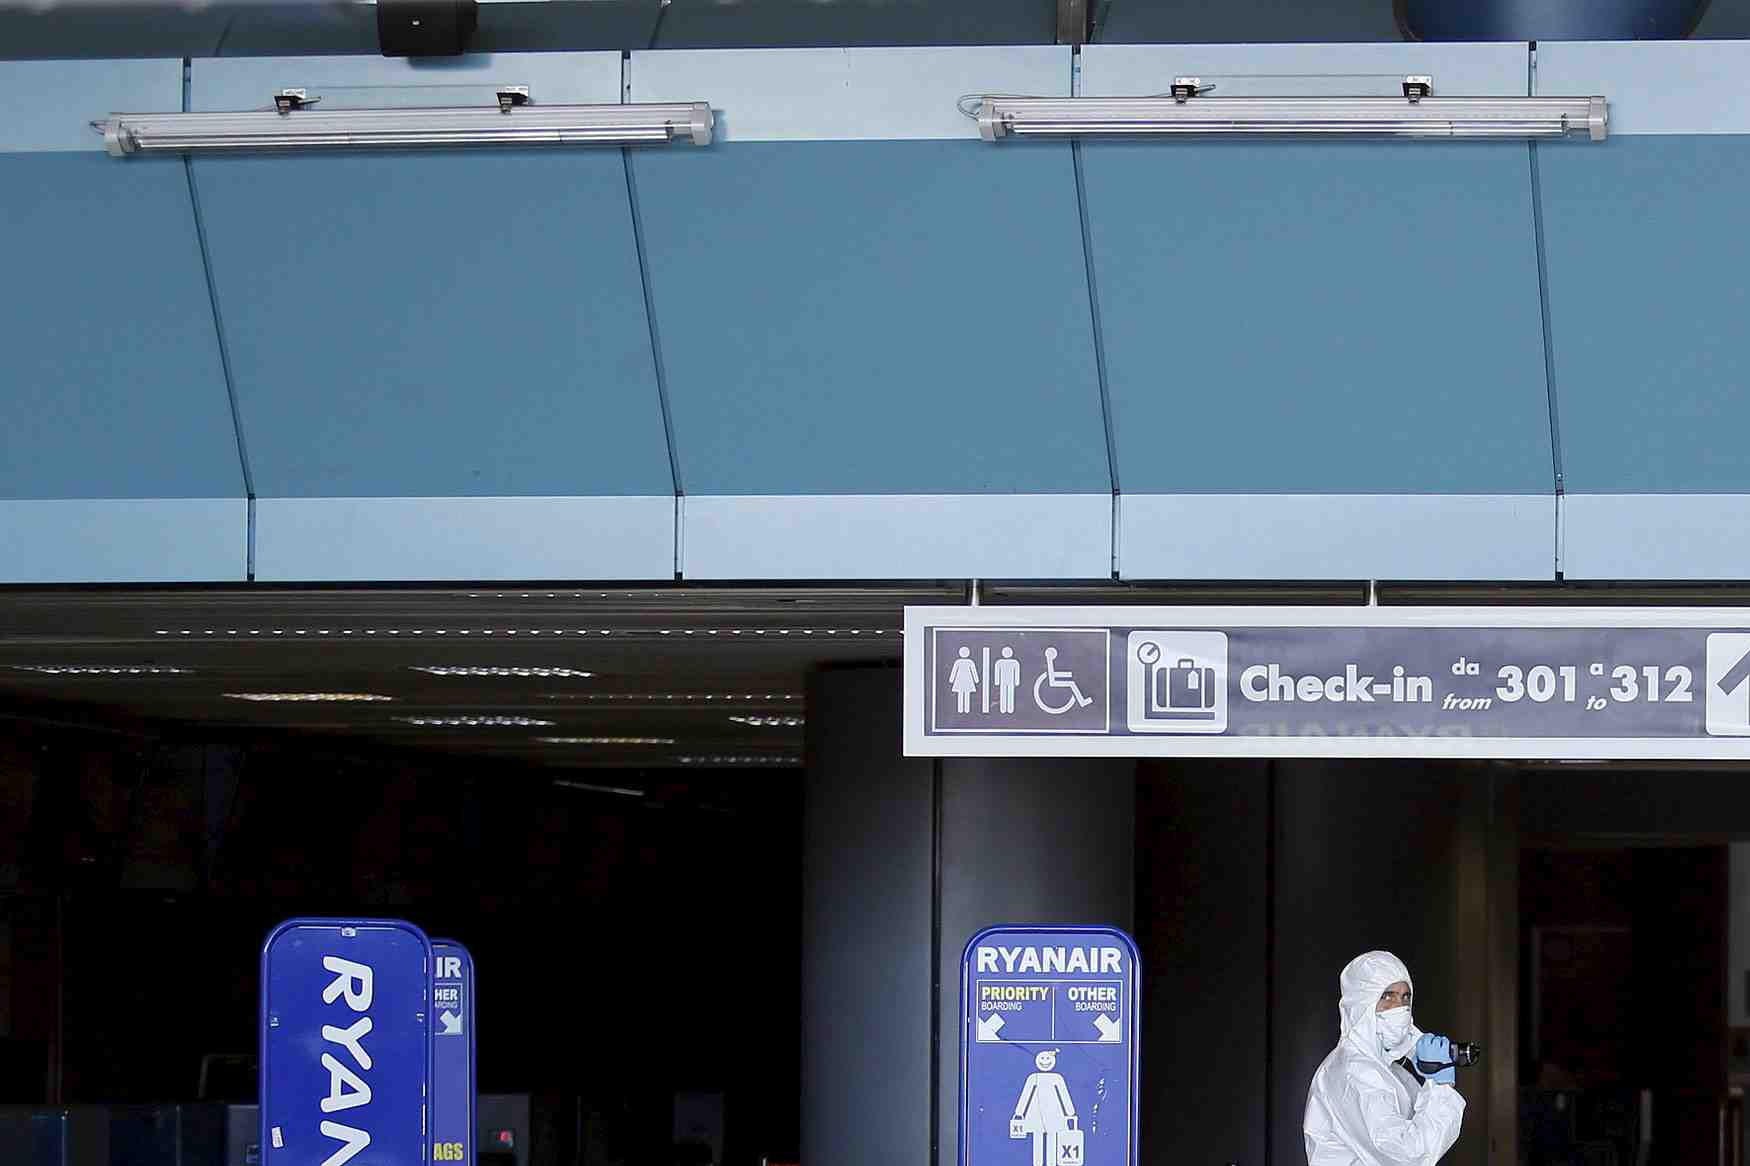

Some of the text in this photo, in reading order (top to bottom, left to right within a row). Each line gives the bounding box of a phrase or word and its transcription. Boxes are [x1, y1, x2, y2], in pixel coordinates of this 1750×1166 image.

[1239, 656, 1694, 702] Check-in da 301 a 312
[1441, 693, 1608, 711] from to
[976, 945, 1122, 974] RYANAIR
[434, 988, 458, 1001] HER
[981, 986, 1049, 1001] PRIORITY
[1067, 986, 1117, 1001] OTHER
[980, 1001, 1023, 1011] BOARDING
[1074, 1001, 1117, 1012] BOARDING
[433, 1142, 465, 1161] AGS
[1061, 1145, 1080, 1159] X1
